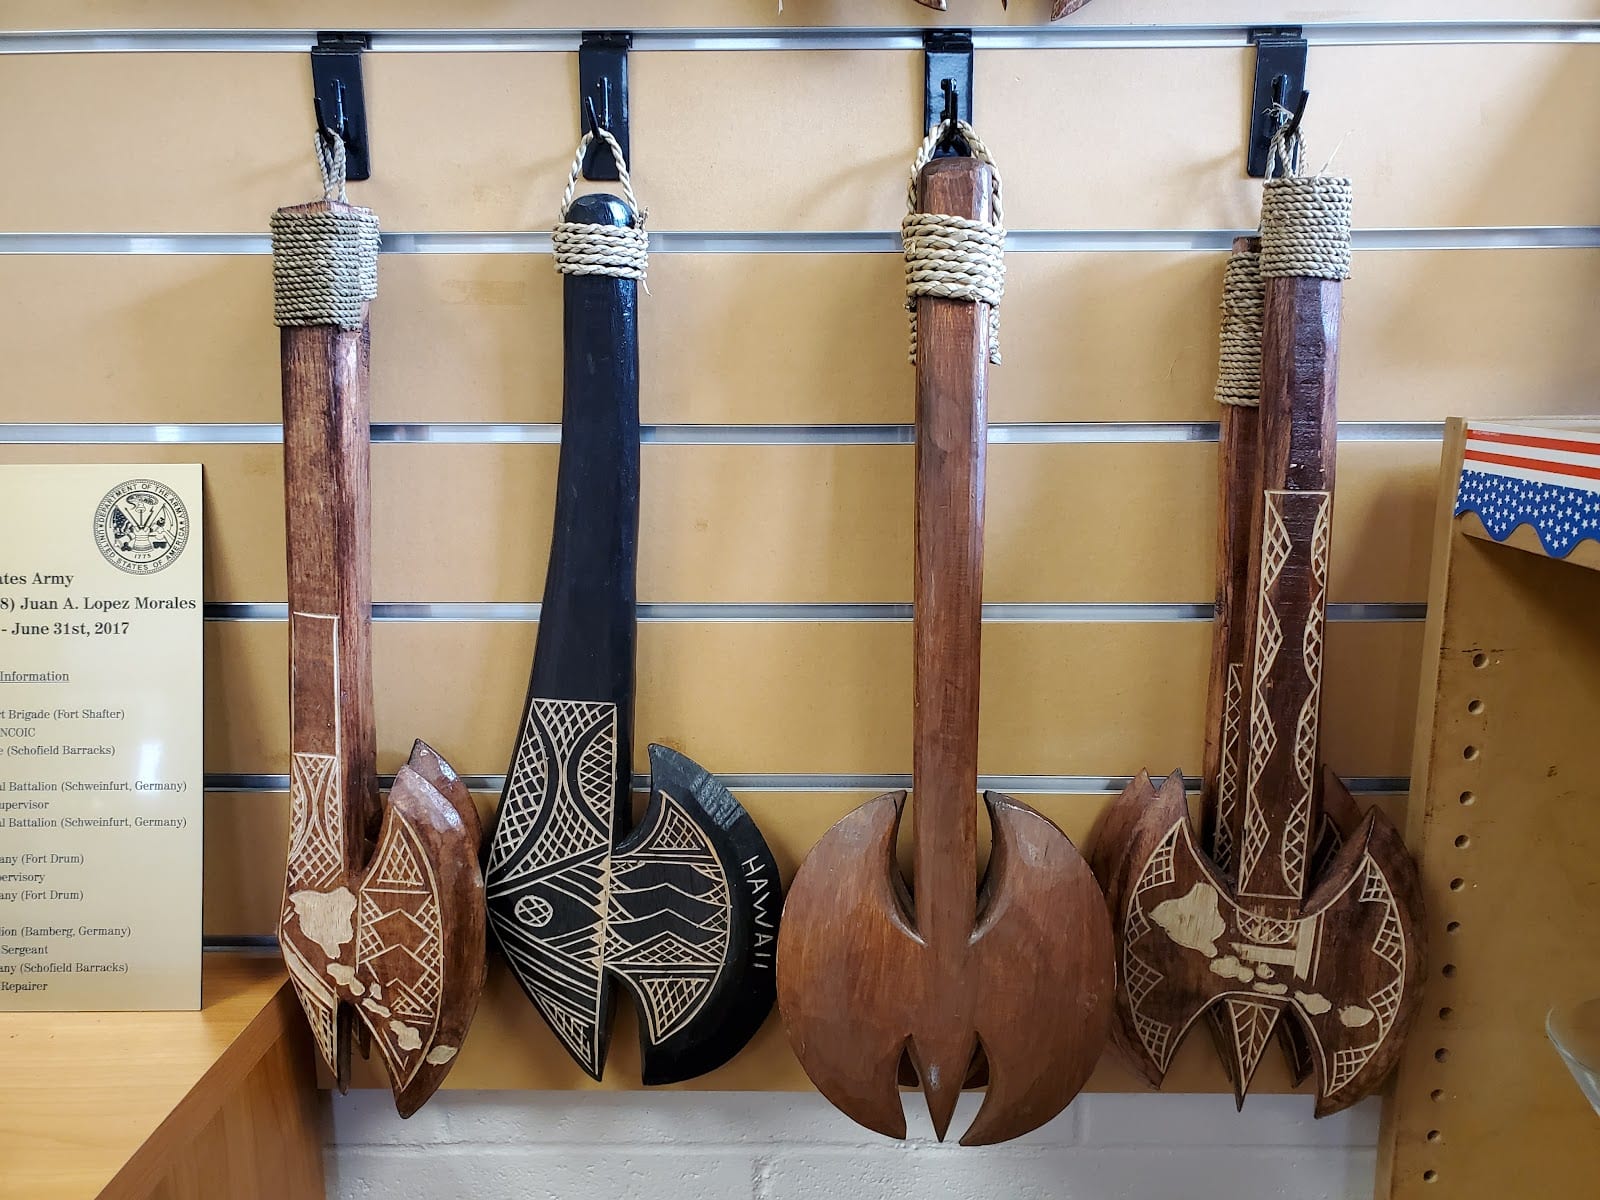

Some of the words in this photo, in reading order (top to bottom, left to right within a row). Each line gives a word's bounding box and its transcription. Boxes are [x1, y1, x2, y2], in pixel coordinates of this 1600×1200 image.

[99, 484, 138, 523] DEPARTMENT
[155, 486, 170, 499] THE
[168, 497, 186, 519] ARMY
[98, 528, 116, 558] UNITED
[115, 557, 149, 571] STATES
[152, 560, 165, 569] OF
[165, 526, 186, 561] AMERICA
[32, 572, 74, 588] Army
[20, 597, 59, 610] Juan
[63, 597, 79, 610] A.
[83, 597, 130, 613] Lopez
[134, 597, 197, 610] Morales
[11, 622, 49, 635] June
[53, 622, 91, 637] 31st,
[94, 622, 130, 635] 2017
[0, 671, 70, 682] Information
[8, 709, 50, 722] Brigade
[53, 709, 79, 721] (Fort
[82, 709, 125, 721] Shafter)
[6, 745, 59, 757] (Schofield
[62, 745, 116, 757] Barracks)
[9, 781, 58, 791] Battalion
[60, 780, 133, 793] (Schweinfurt,
[135, 780, 187, 793] Germany)
[9, 817, 57, 828] Battalion
[60, 816, 132, 829] (Schweinfurt,
[134, 816, 187, 829] Germany)
[21, 853, 48, 866] (Fort
[50, 853, 84, 866] Drum)
[21, 889, 47, 902] (Fort
[50, 889, 84, 902] Drum)
[741, 855, 774, 969] HAWAII
[21, 926, 76, 939] (Bamberg,
[78, 925, 132, 939] Germany)
[1, 944, 49, 957] Sergeant
[20, 962, 73, 975] (Schofield
[75, 962, 129, 975] Barracks)
[0, 980, 48, 993] Repairer
